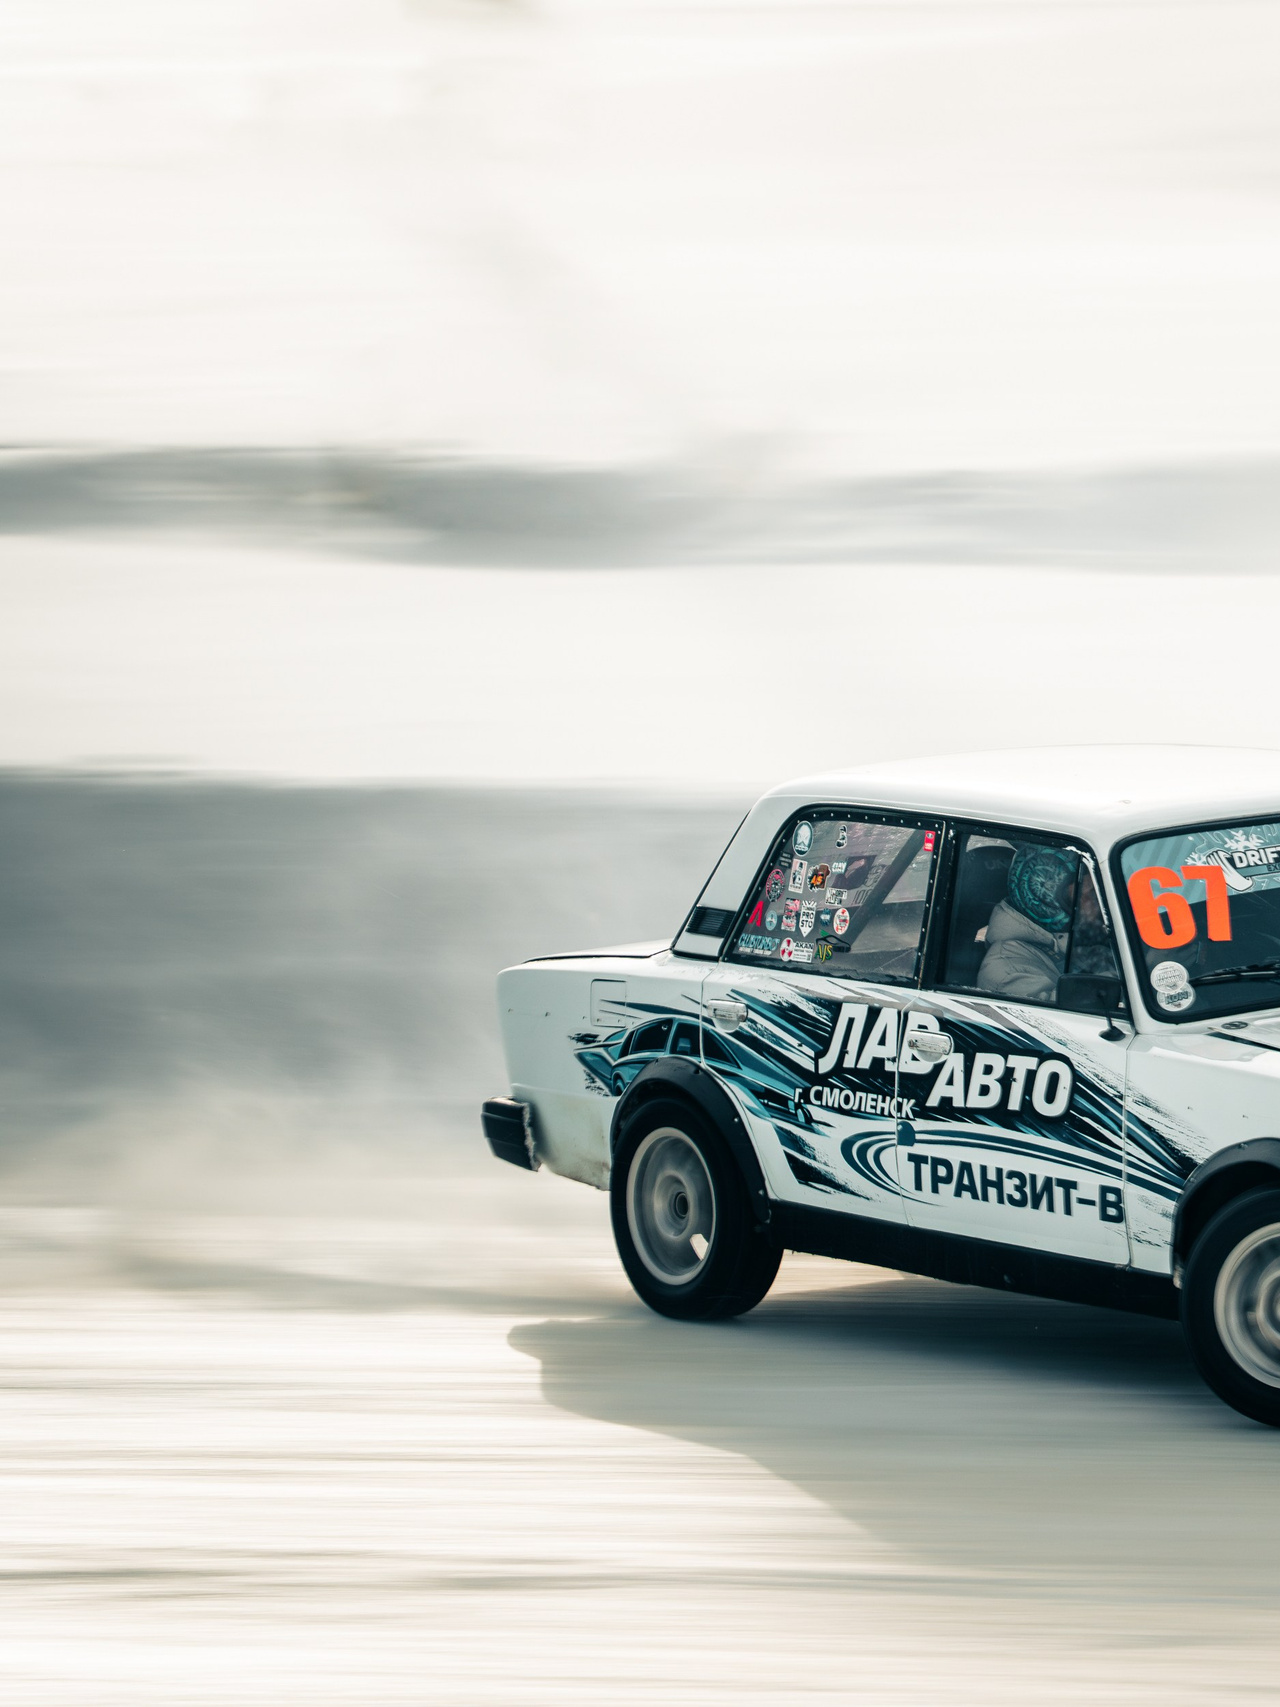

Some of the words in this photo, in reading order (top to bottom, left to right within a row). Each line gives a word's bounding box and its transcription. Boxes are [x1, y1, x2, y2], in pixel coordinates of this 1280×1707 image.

[800, 919, 813, 929] STO
[802, 911, 815, 920] PRO
[1127, 864, 1233, 951] 67
[795, 940, 815, 950] AKAN
[818, 1002, 946, 1075] ЛАВ
[925, 1051, 1073, 1118] АВТО
[809, 1085, 916, 1120] СМОЛЕНСК
[907, 1152, 1125, 1224] ТРАНЗИТ-В
